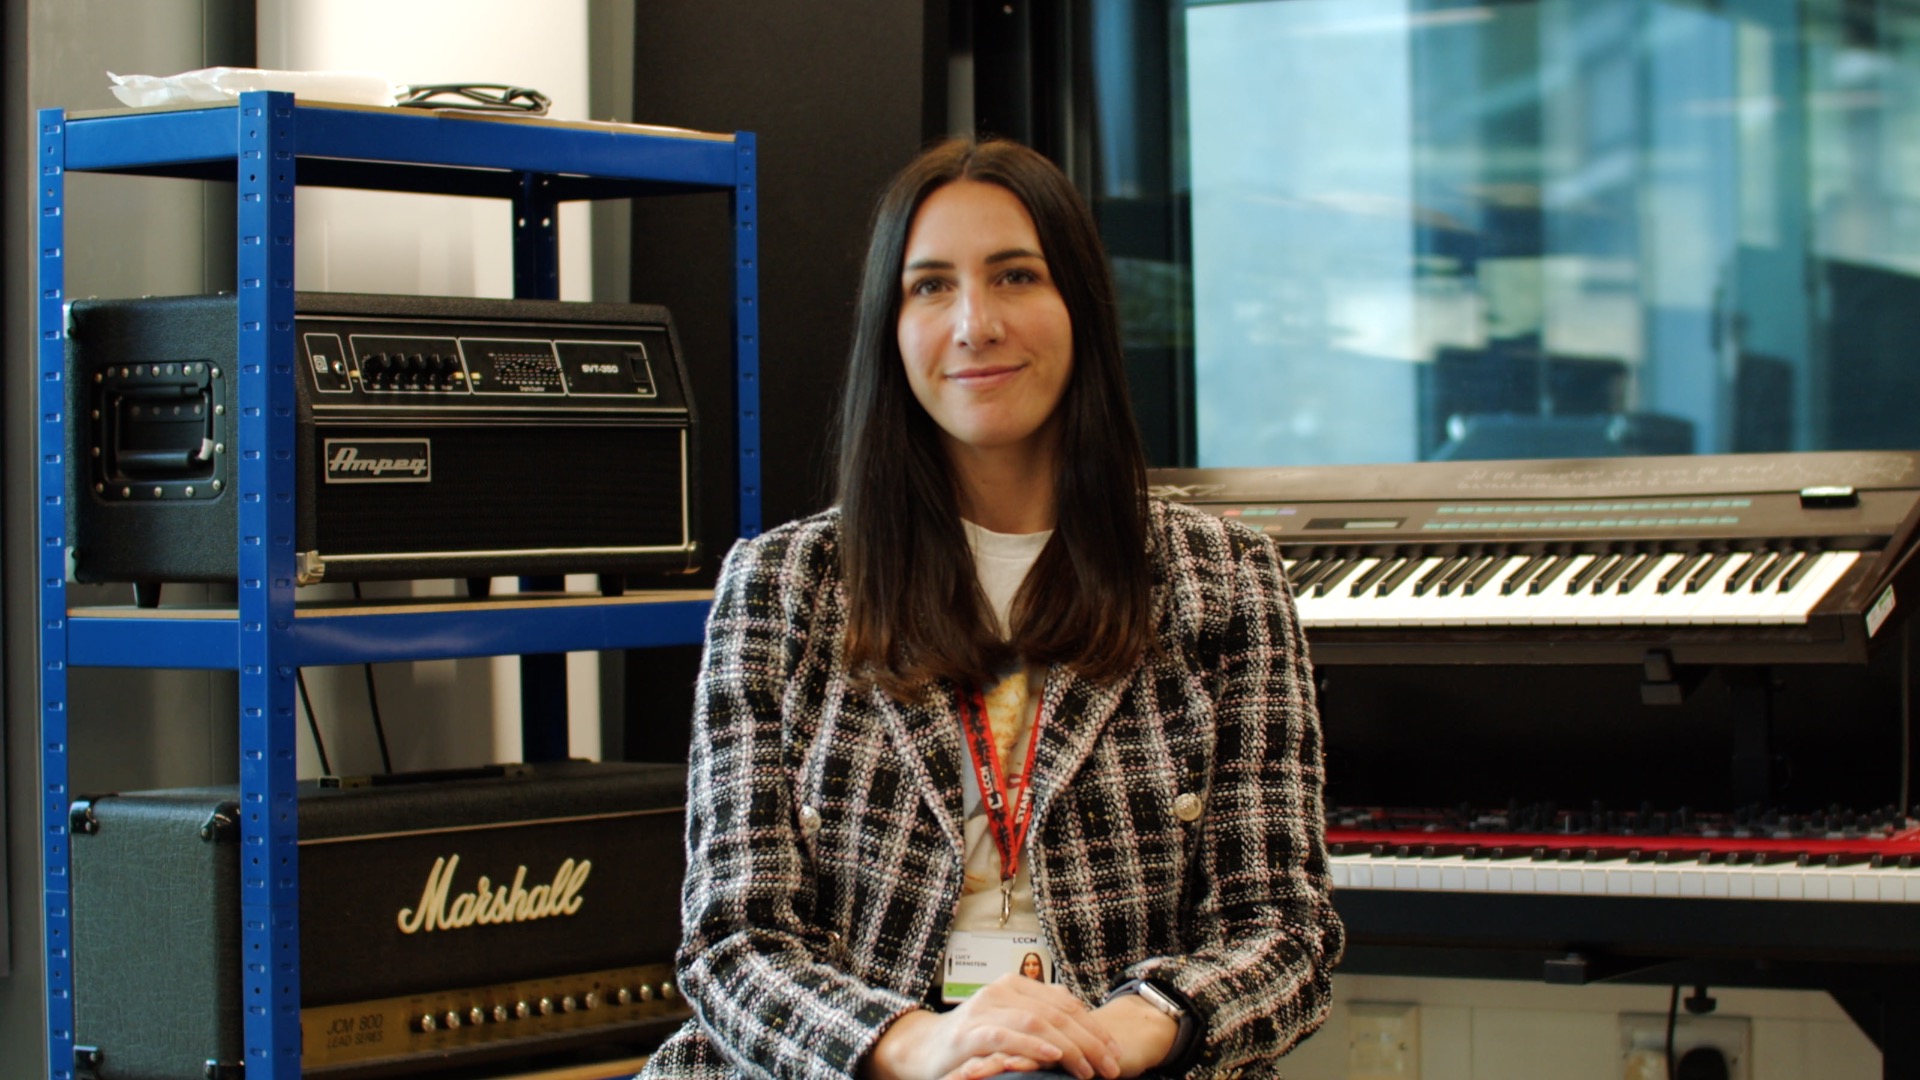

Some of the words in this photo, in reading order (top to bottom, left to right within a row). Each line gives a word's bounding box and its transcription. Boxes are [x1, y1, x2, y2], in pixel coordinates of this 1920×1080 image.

[581, 364, 619, 374] SVT-350
[329, 447, 427, 475] Ampeg
[397, 853, 592, 934] Marshall
[1012, 936, 1038, 944] LCCM
[326, 1016, 355, 1036] JCM
[359, 1013, 384, 1031] 800
[326, 1034, 353, 1049] LEAD
[355, 1030, 384, 1045] SERIES
